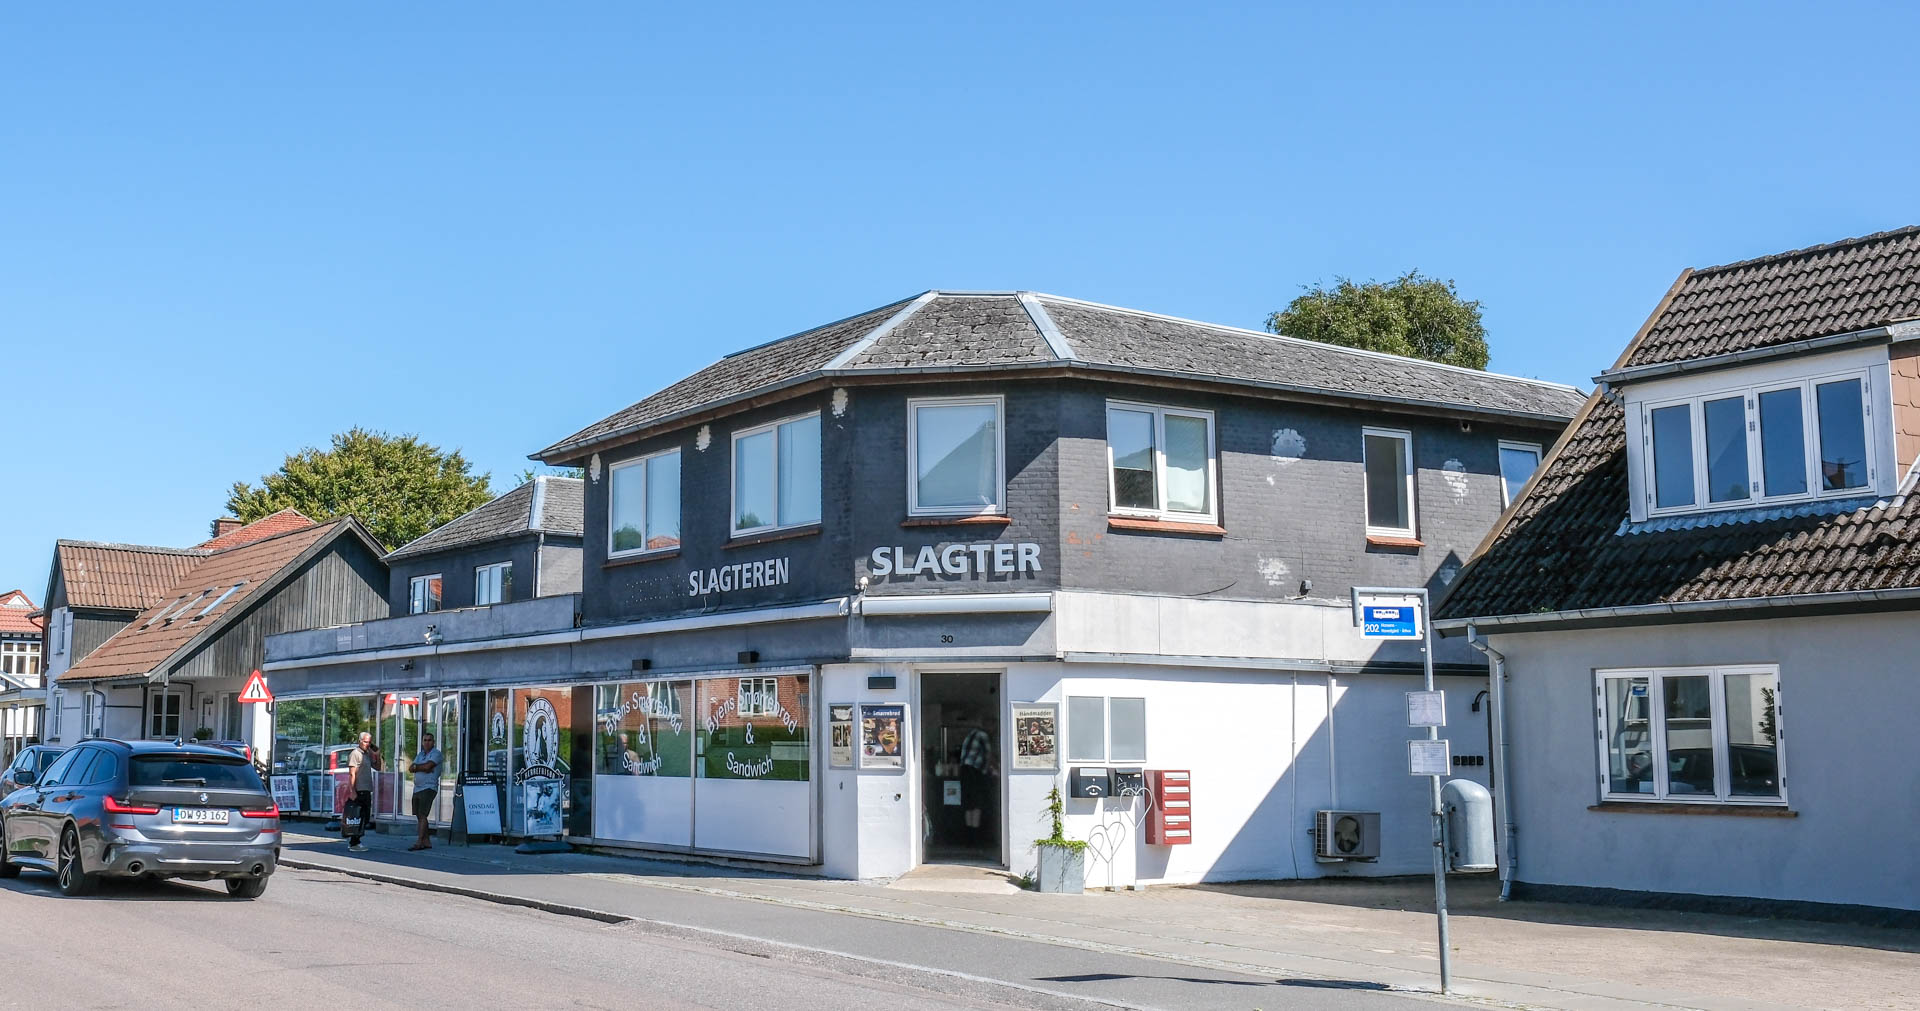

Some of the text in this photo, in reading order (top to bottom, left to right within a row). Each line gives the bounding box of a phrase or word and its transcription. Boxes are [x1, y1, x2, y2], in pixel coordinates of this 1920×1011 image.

[871, 542, 1042, 576] SLAGTER
[689, 557, 789, 597] SLAGTEREN
[940, 634, 954, 643] 30
[1364, 623, 1380, 633] 202
[606, 692, 682, 736] Byens Smørrebrød
[706, 687, 797, 735] Byens Smørrebrød
[639, 724, 646, 744] &
[746, 722, 754, 744] &
[622, 751, 662, 774] Sandwich
[726, 751, 773, 777] Sandwich
[180, 810, 227, 821] DW 93 162
